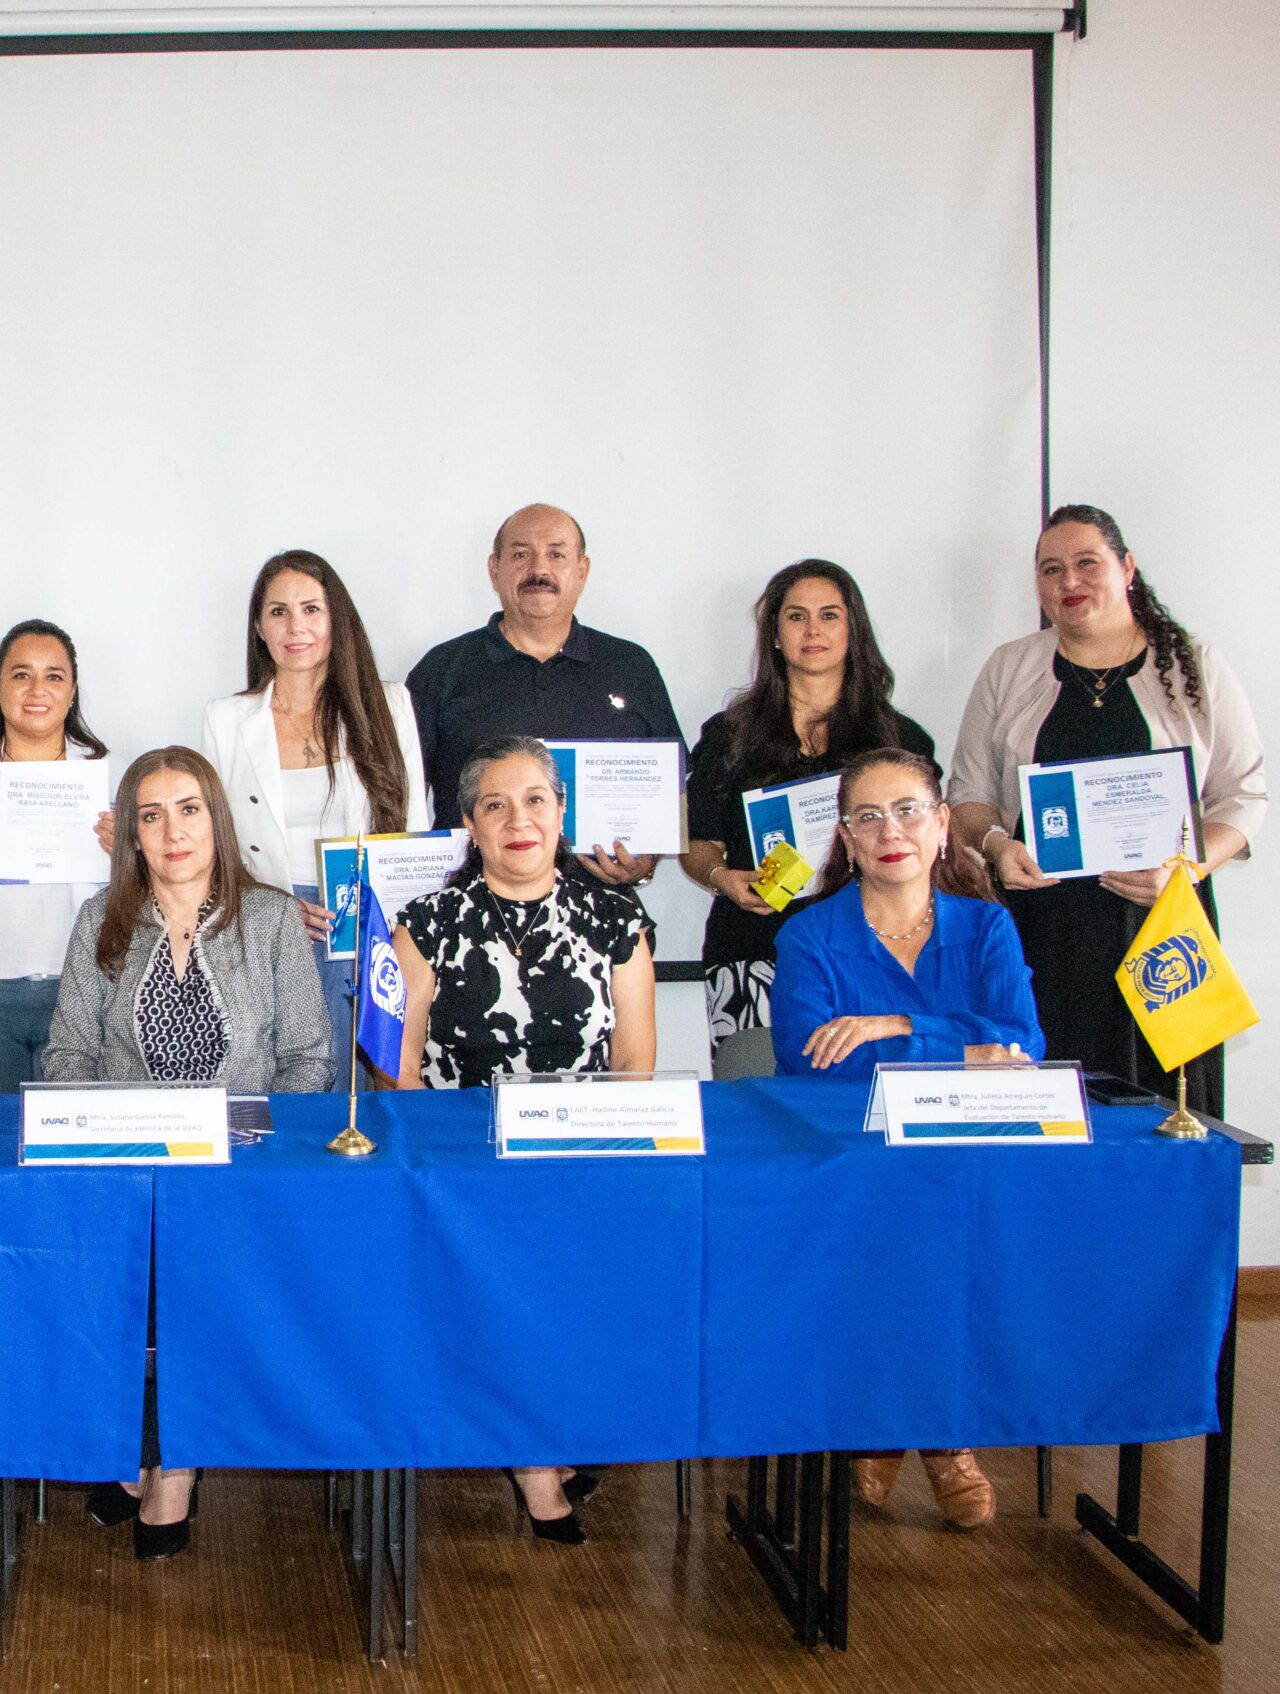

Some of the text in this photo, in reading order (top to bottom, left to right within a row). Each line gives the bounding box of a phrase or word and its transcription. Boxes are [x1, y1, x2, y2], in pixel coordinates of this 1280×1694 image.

[1084, 771, 1162, 786] RECONOCIMIENTO
[9, 781, 84, 790] RECONOCIMIENTO
[1126, 781, 1148, 789] CELIA
[1106, 788, 1152, 798] ESMERALDA
[39, 800, 79, 808] ARELLANO
[378, 855, 453, 865] RECONOCIMIENTO
[990, 1104, 1037, 1112] Departamento
[519, 1110, 549, 1118] UVAQ
[41, 1117, 69, 1125] UVAQ
[647, 1119, 677, 1127] Humano
